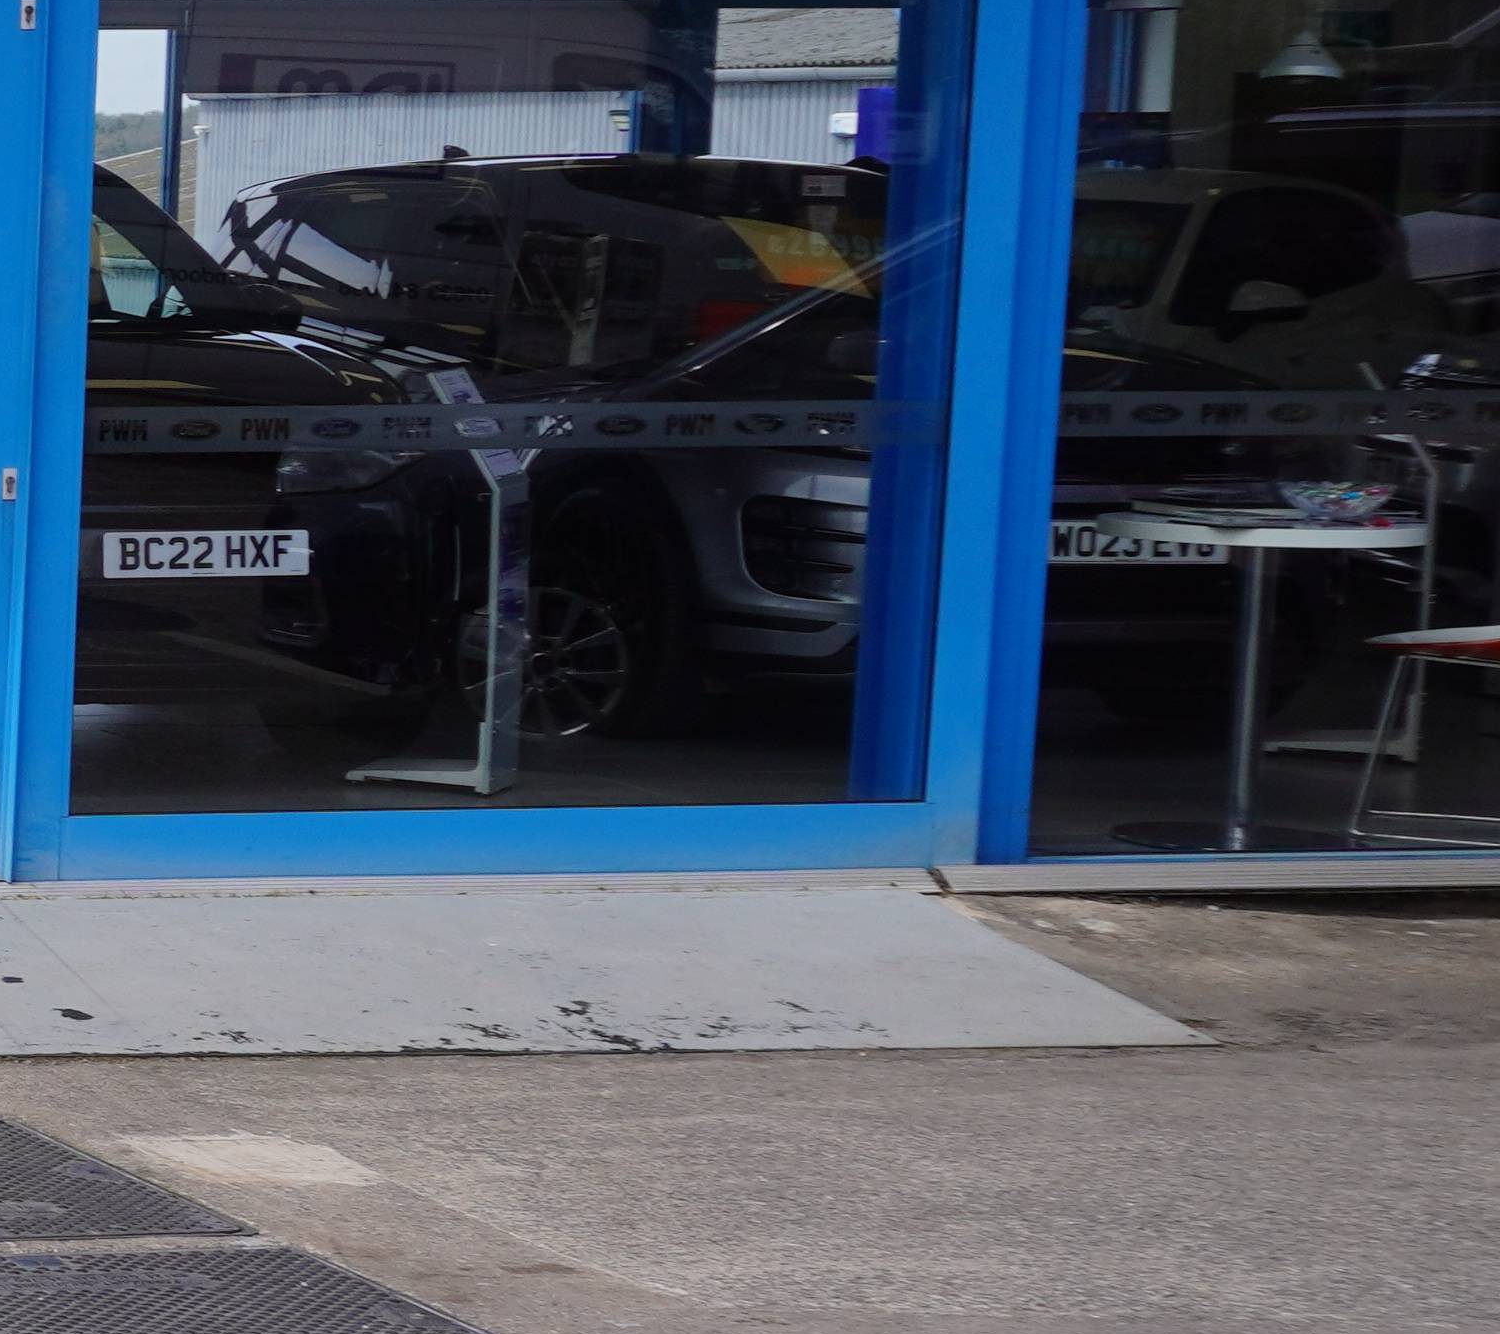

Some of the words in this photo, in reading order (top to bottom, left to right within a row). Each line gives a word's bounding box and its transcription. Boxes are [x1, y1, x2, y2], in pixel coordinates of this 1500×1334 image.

[99, 418, 149, 442] PWM
[240, 417, 291, 441] PWM
[119, 536, 214, 571] BC22
[226, 534, 293, 569] HXF
